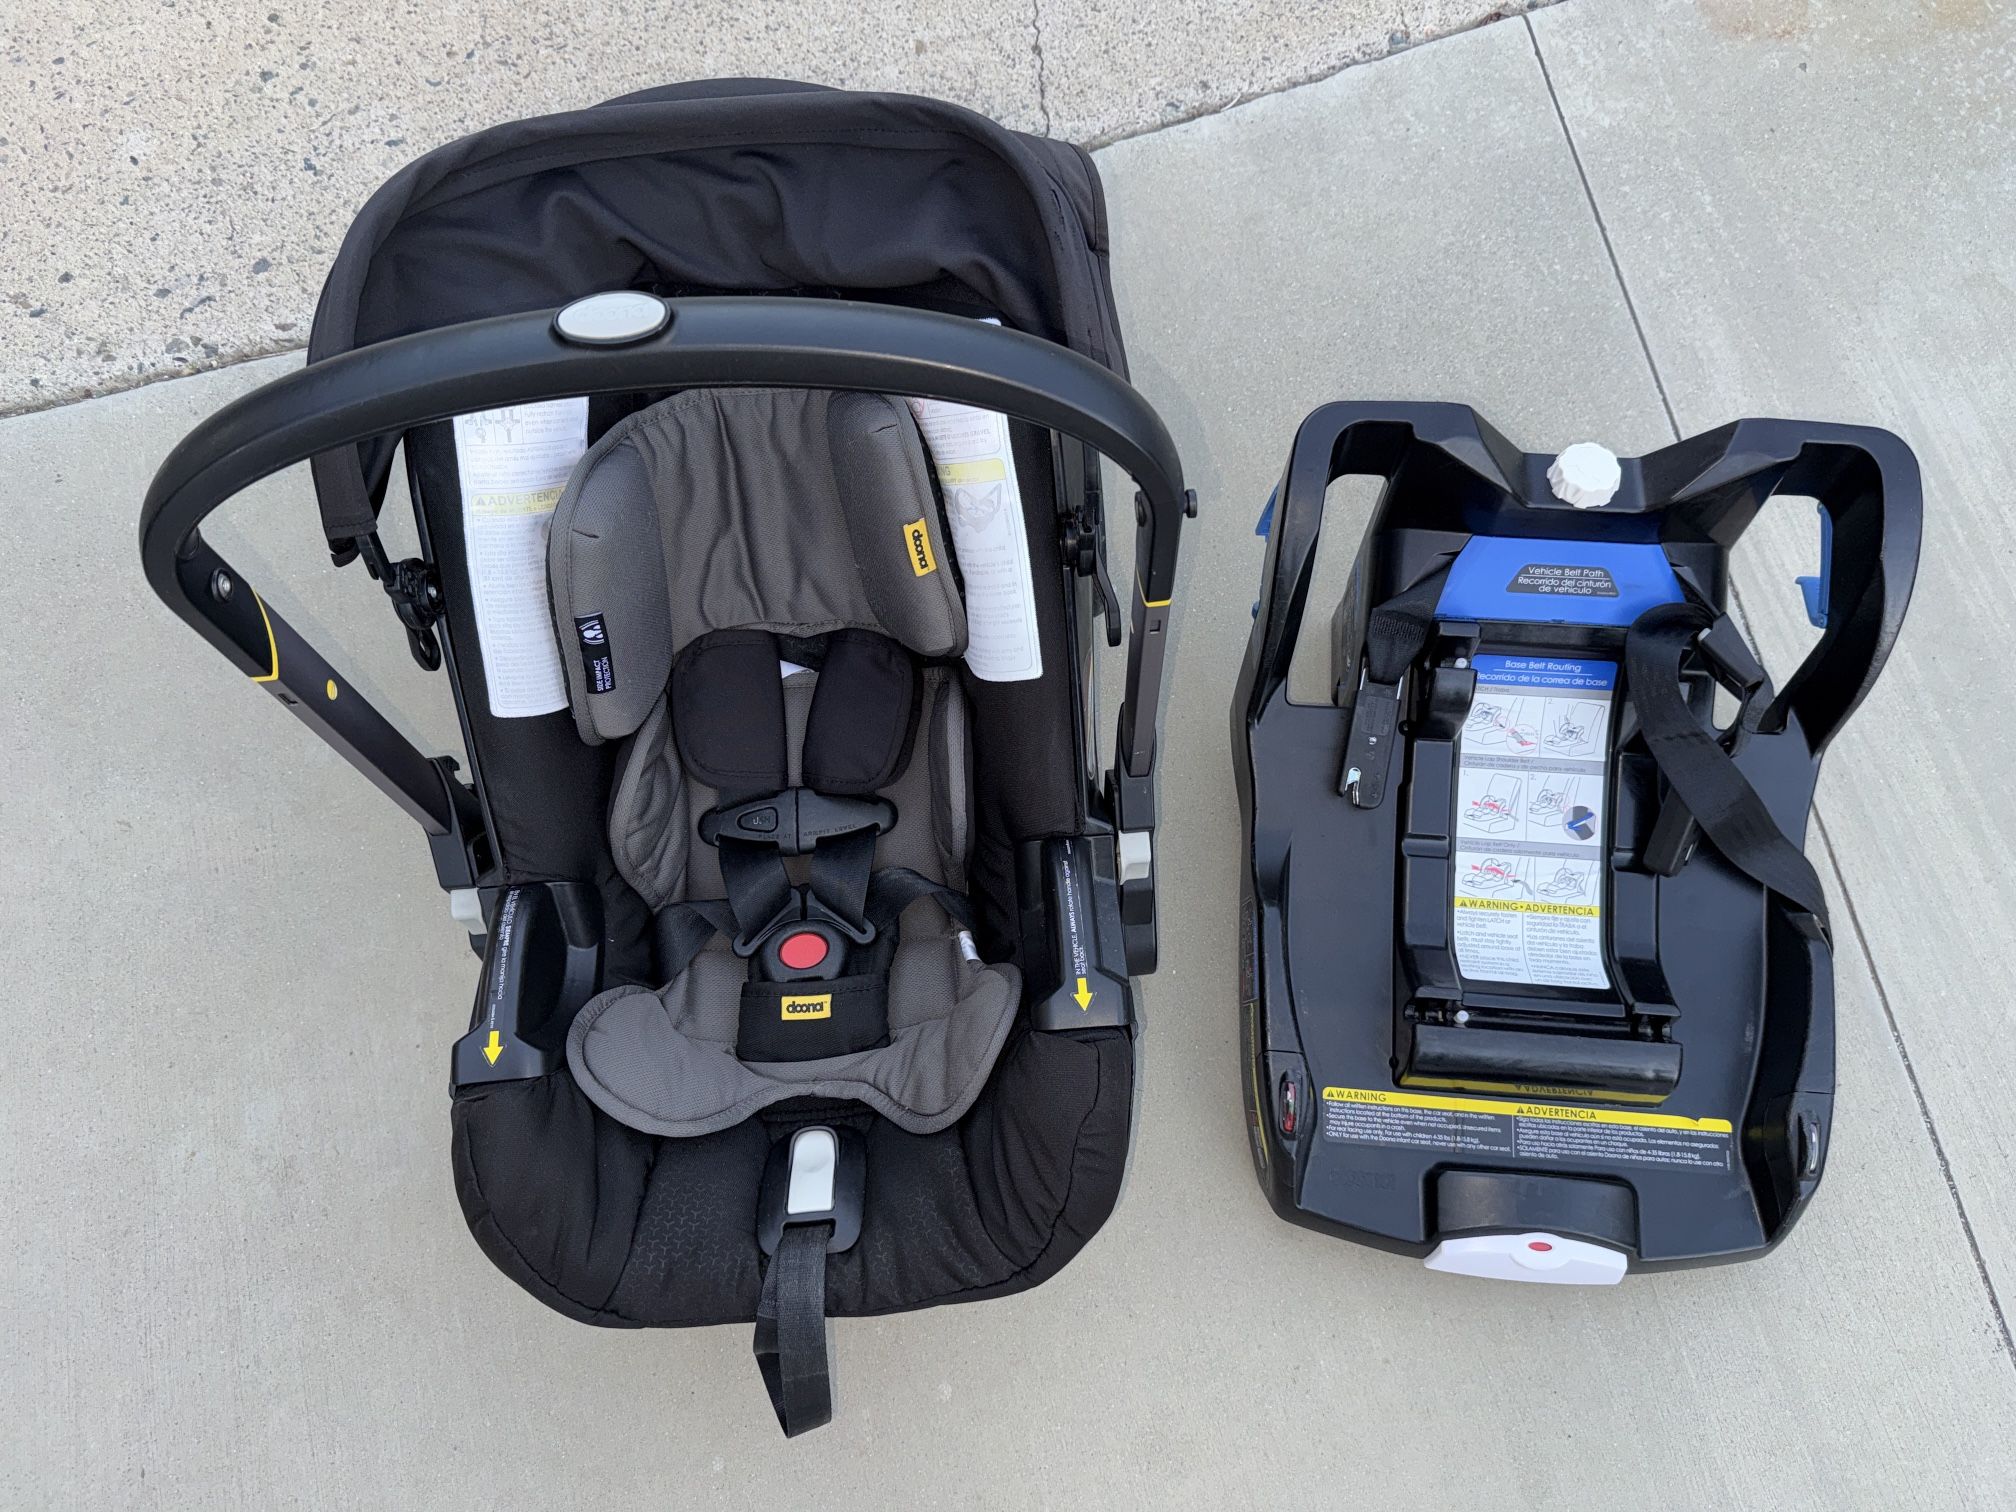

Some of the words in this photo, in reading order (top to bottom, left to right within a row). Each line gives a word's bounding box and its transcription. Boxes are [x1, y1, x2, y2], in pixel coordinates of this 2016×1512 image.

[912, 529, 928, 569] doona
[1528, 567, 1562, 575] Vehicle
[1583, 569, 1604, 577] Path
[1518, 576, 1559, 586] Recorrido
[1561, 578, 1575, 586] del
[1576, 579, 1611, 588] cinturón
[593, 660, 602, 680] IMPACT
[601, 656, 612, 690] PROTECTION
[1505, 660, 1526, 668] Base
[1548, 662, 1582, 673] Routing
[1518, 674, 1530, 682] de
[1572, 676, 1584, 685] de
[1586, 678, 1608, 686] base
[1469, 900, 1518, 911] WARNING
[1525, 904, 1593, 916] ADVERTENCIA
[786, 1001, 824, 1013] doona
[1336, 1090, 1386, 1102] WARNING
[1526, 1106, 1596, 1120] ADVERTENCIA
